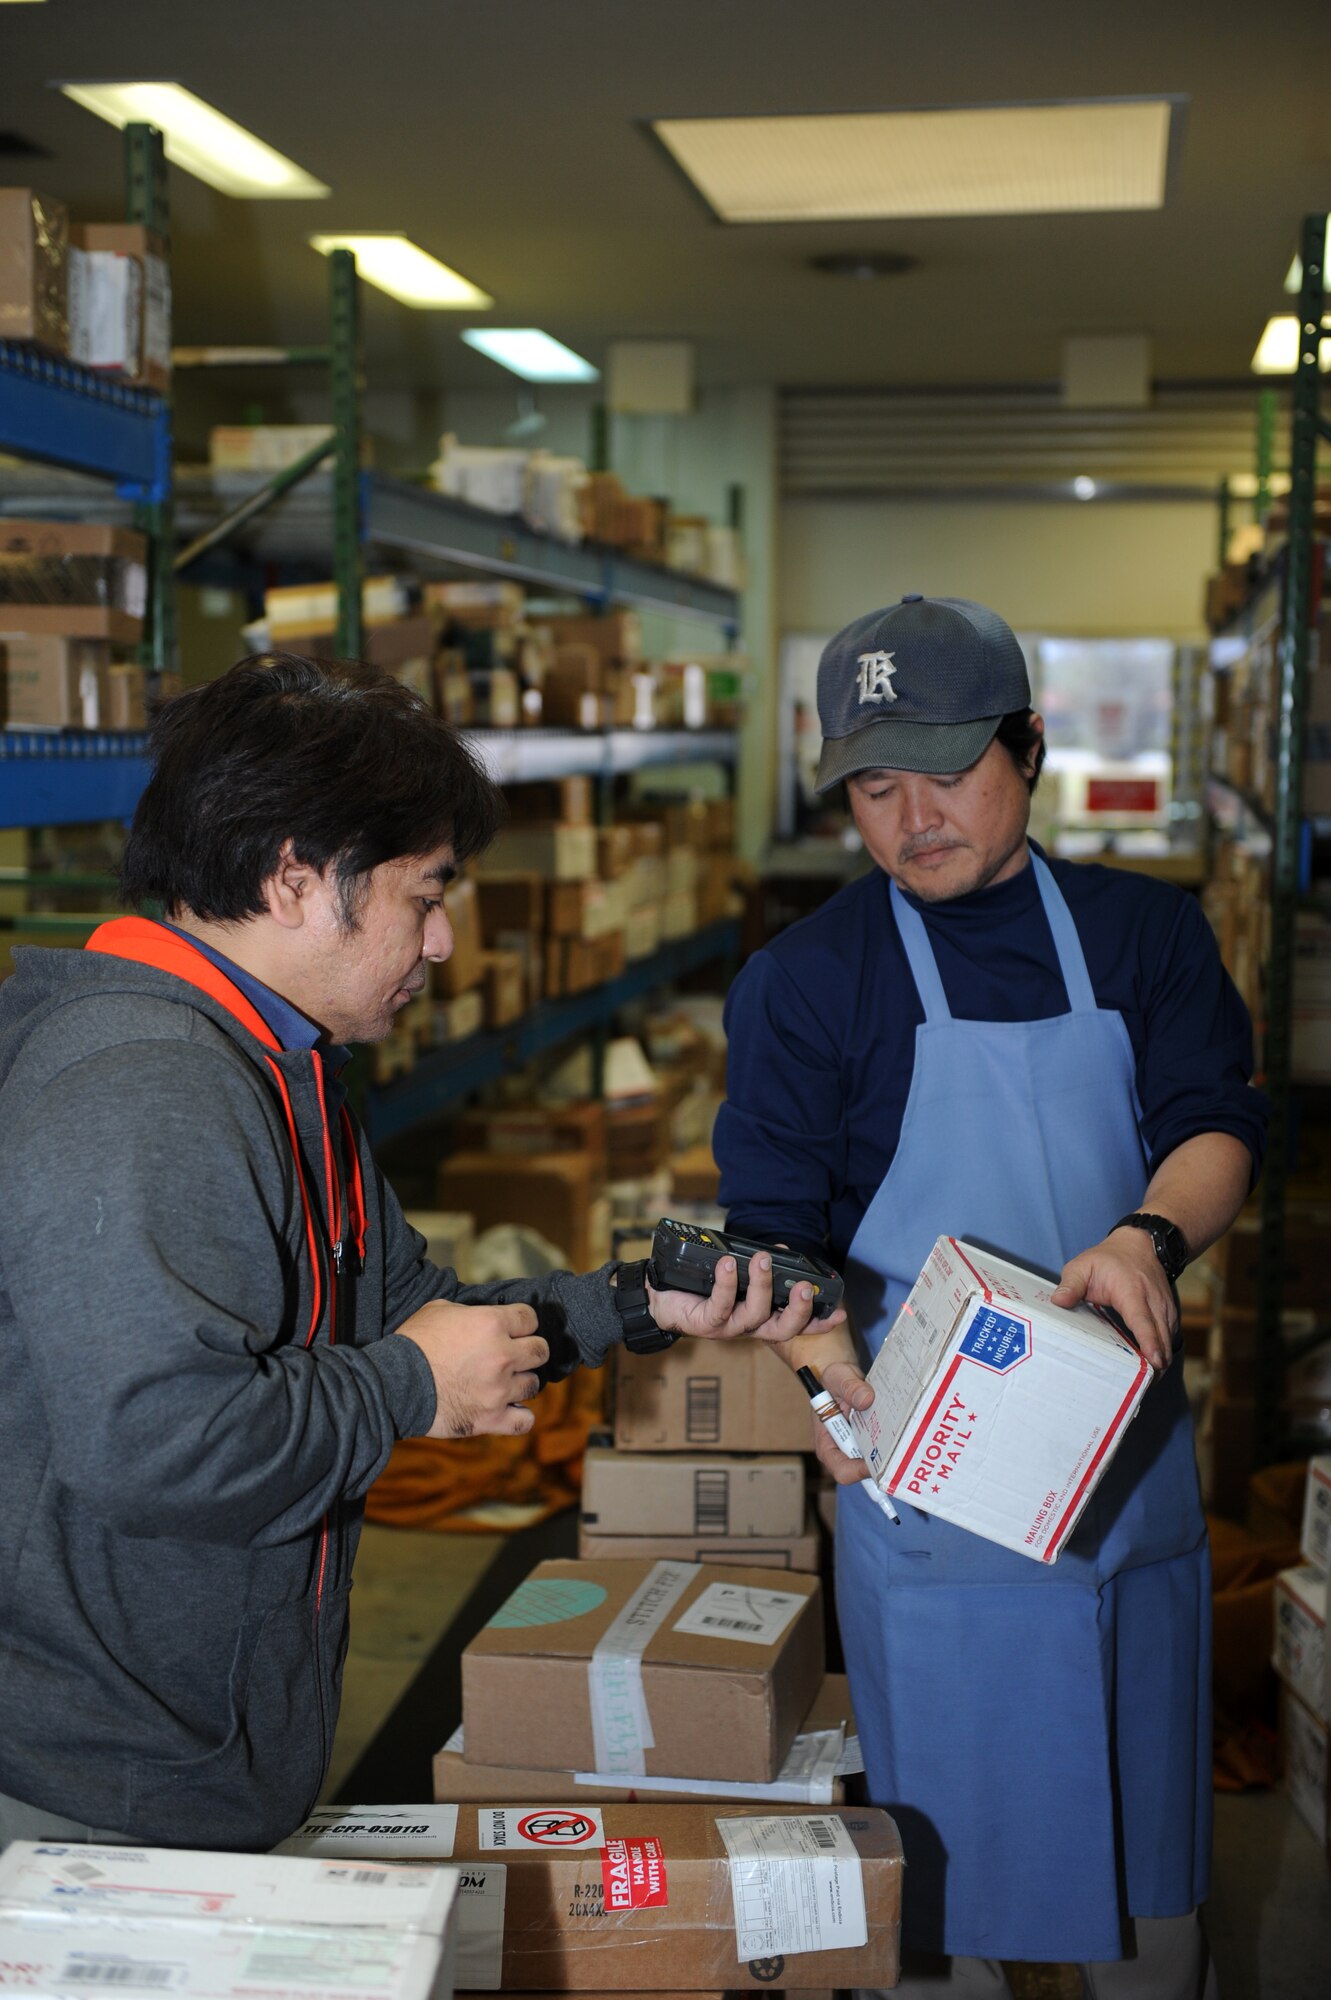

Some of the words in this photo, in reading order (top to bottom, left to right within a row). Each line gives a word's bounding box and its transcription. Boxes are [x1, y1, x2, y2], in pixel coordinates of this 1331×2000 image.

[971, 1313, 997, 1354] TRACKED
[993, 1323, 1018, 1364] INSURED
[907, 1393, 966, 1495] PRIORITY
[937, 1431, 972, 1480] MAIL
[1041, 1504, 1061, 1535] DOMESTIC
[1058, 1488, 1068, 1503] AND
[1066, 1440, 1095, 1488] INTERNATIONAL
[1024, 1509, 1048, 1545] MAILING
[1043, 1489, 1058, 1509] BOX
[625, 1588, 669, 1625] STITCH
[492, 1811, 505, 1819] DO
[493, 1820, 506, 1830] NOT
[493, 1831, 506, 1847] STACK
[644, 1842, 657, 1859] CARE
[606, 1840, 629, 1907] FRAGILE
[630, 1846, 645, 1885] HANDLE
[648, 1859, 660, 1895] WITH
